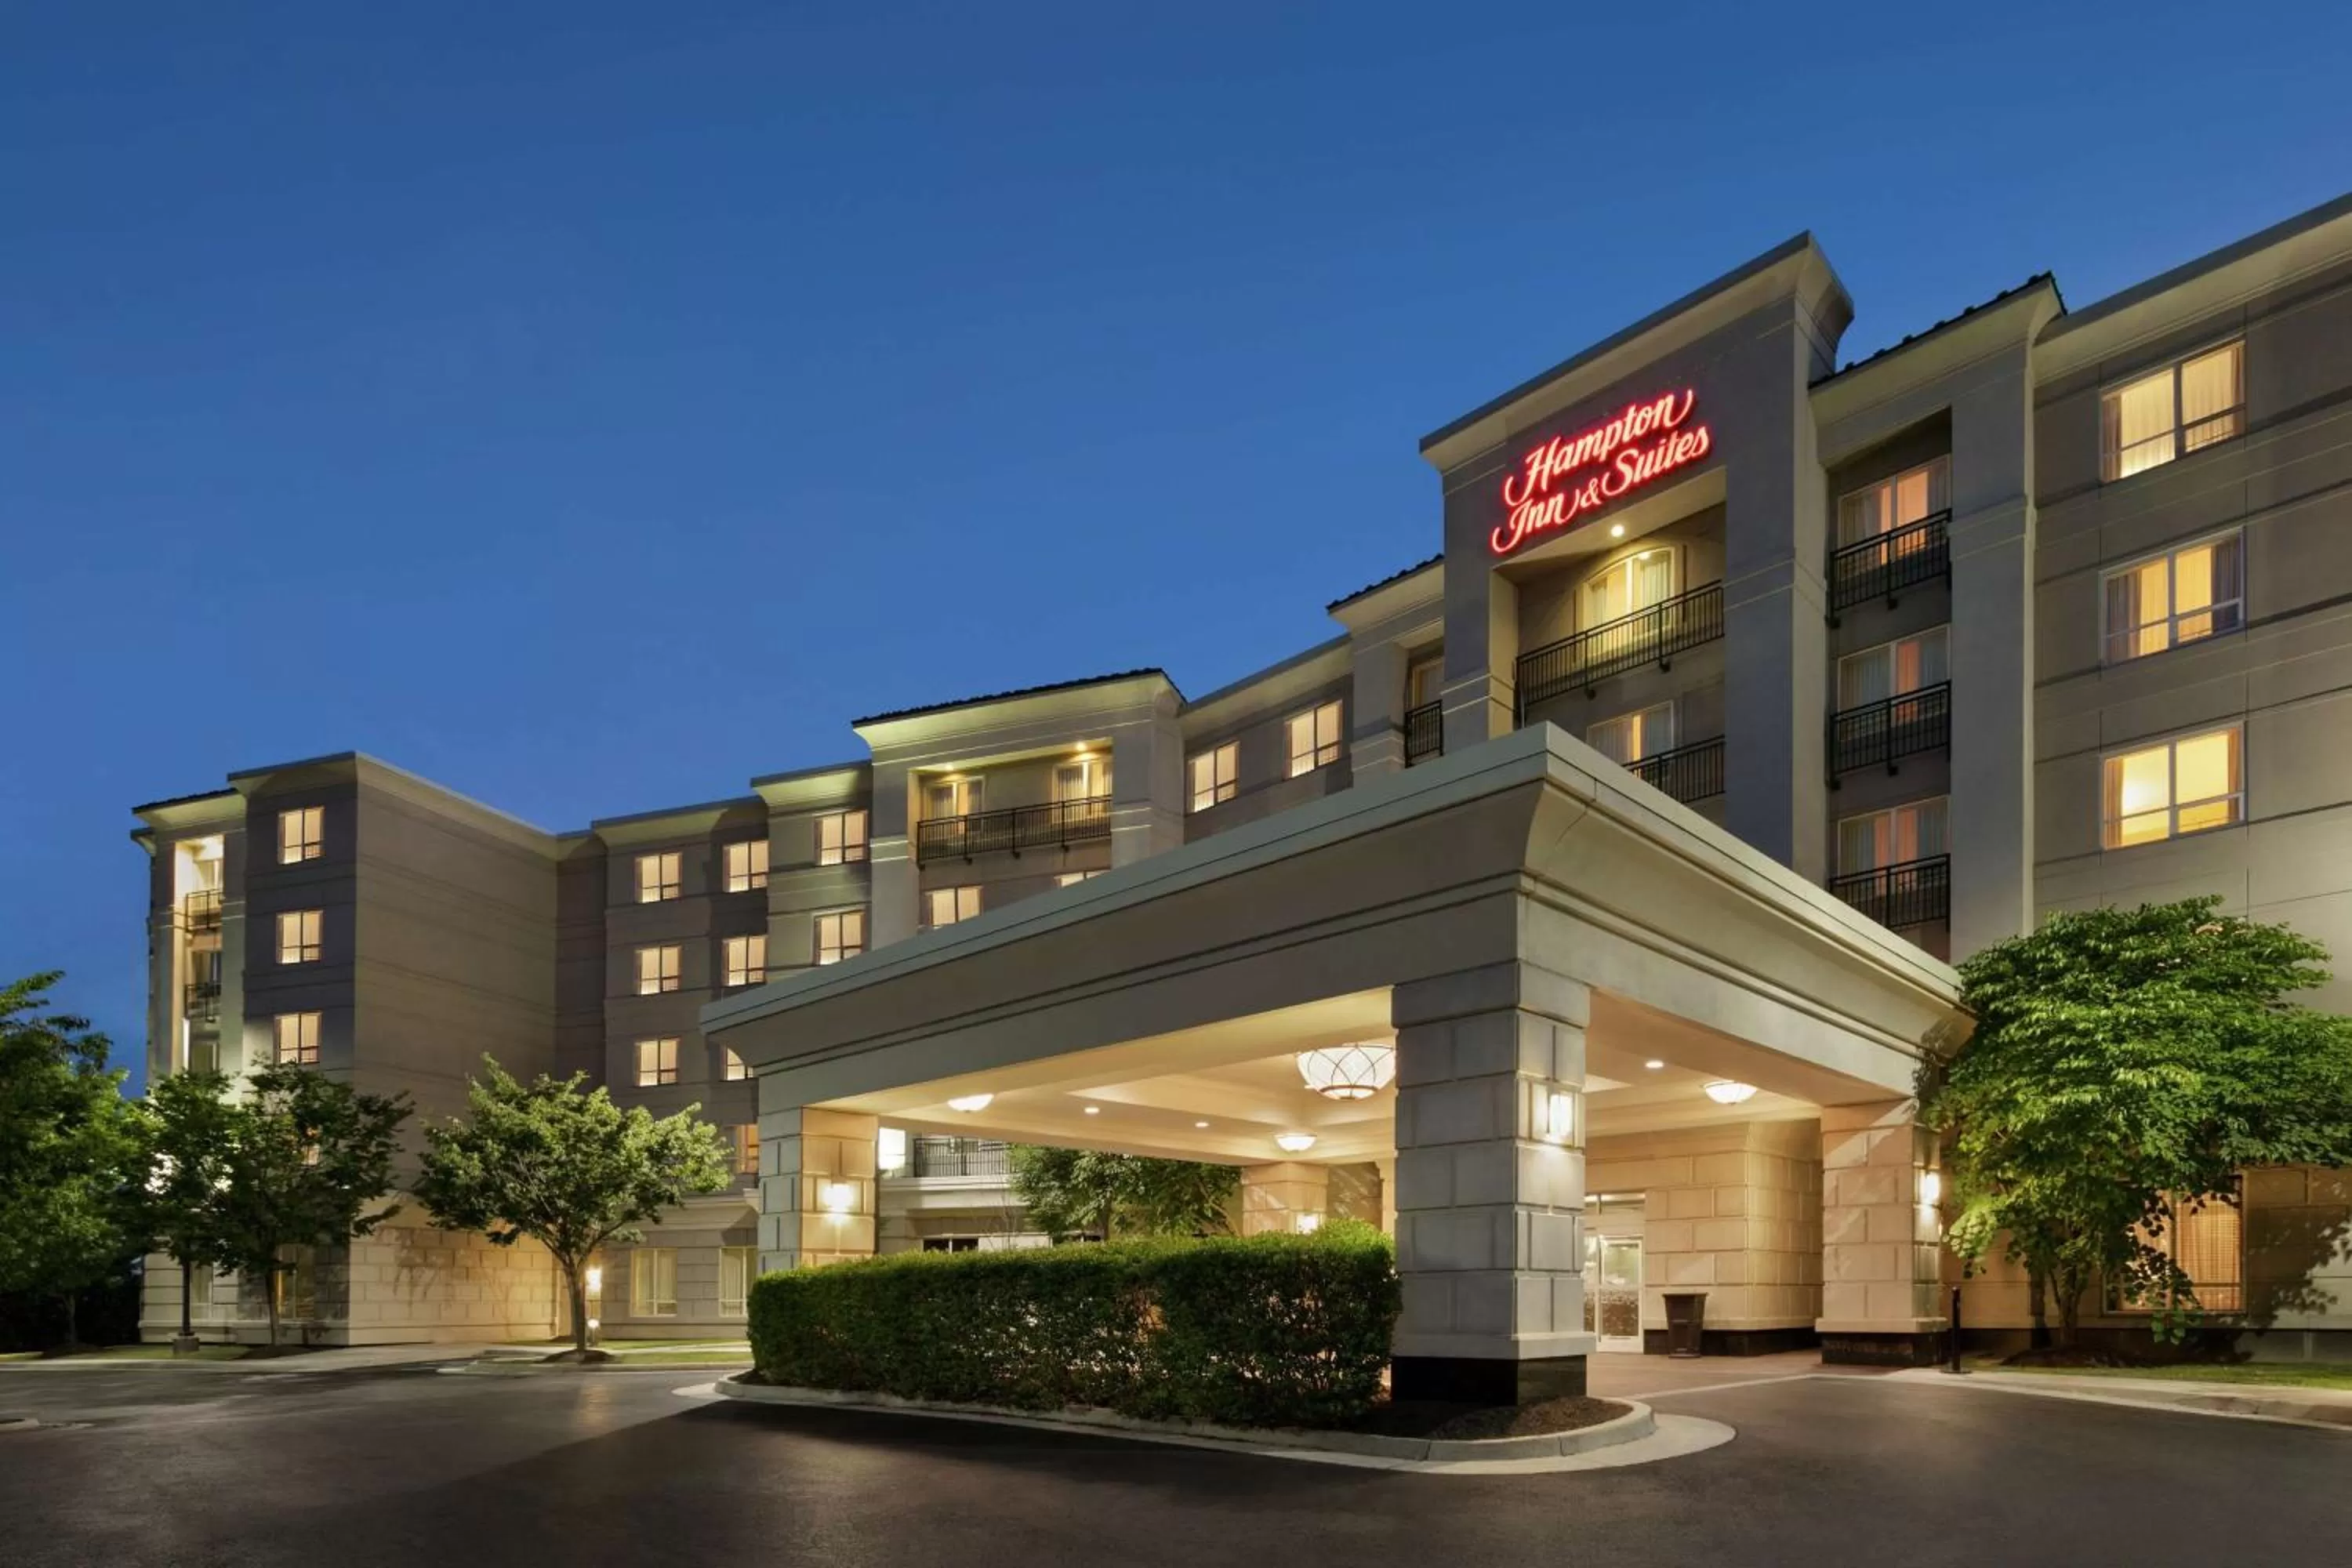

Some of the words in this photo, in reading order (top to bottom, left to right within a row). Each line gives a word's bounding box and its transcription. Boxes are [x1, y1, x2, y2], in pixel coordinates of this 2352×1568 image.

[1492, 489, 1580, 553] Inn
[1581, 477, 1601, 509] &
[1602, 426, 1710, 496] Suites
[1504, 389, 1693, 506] Hampton
